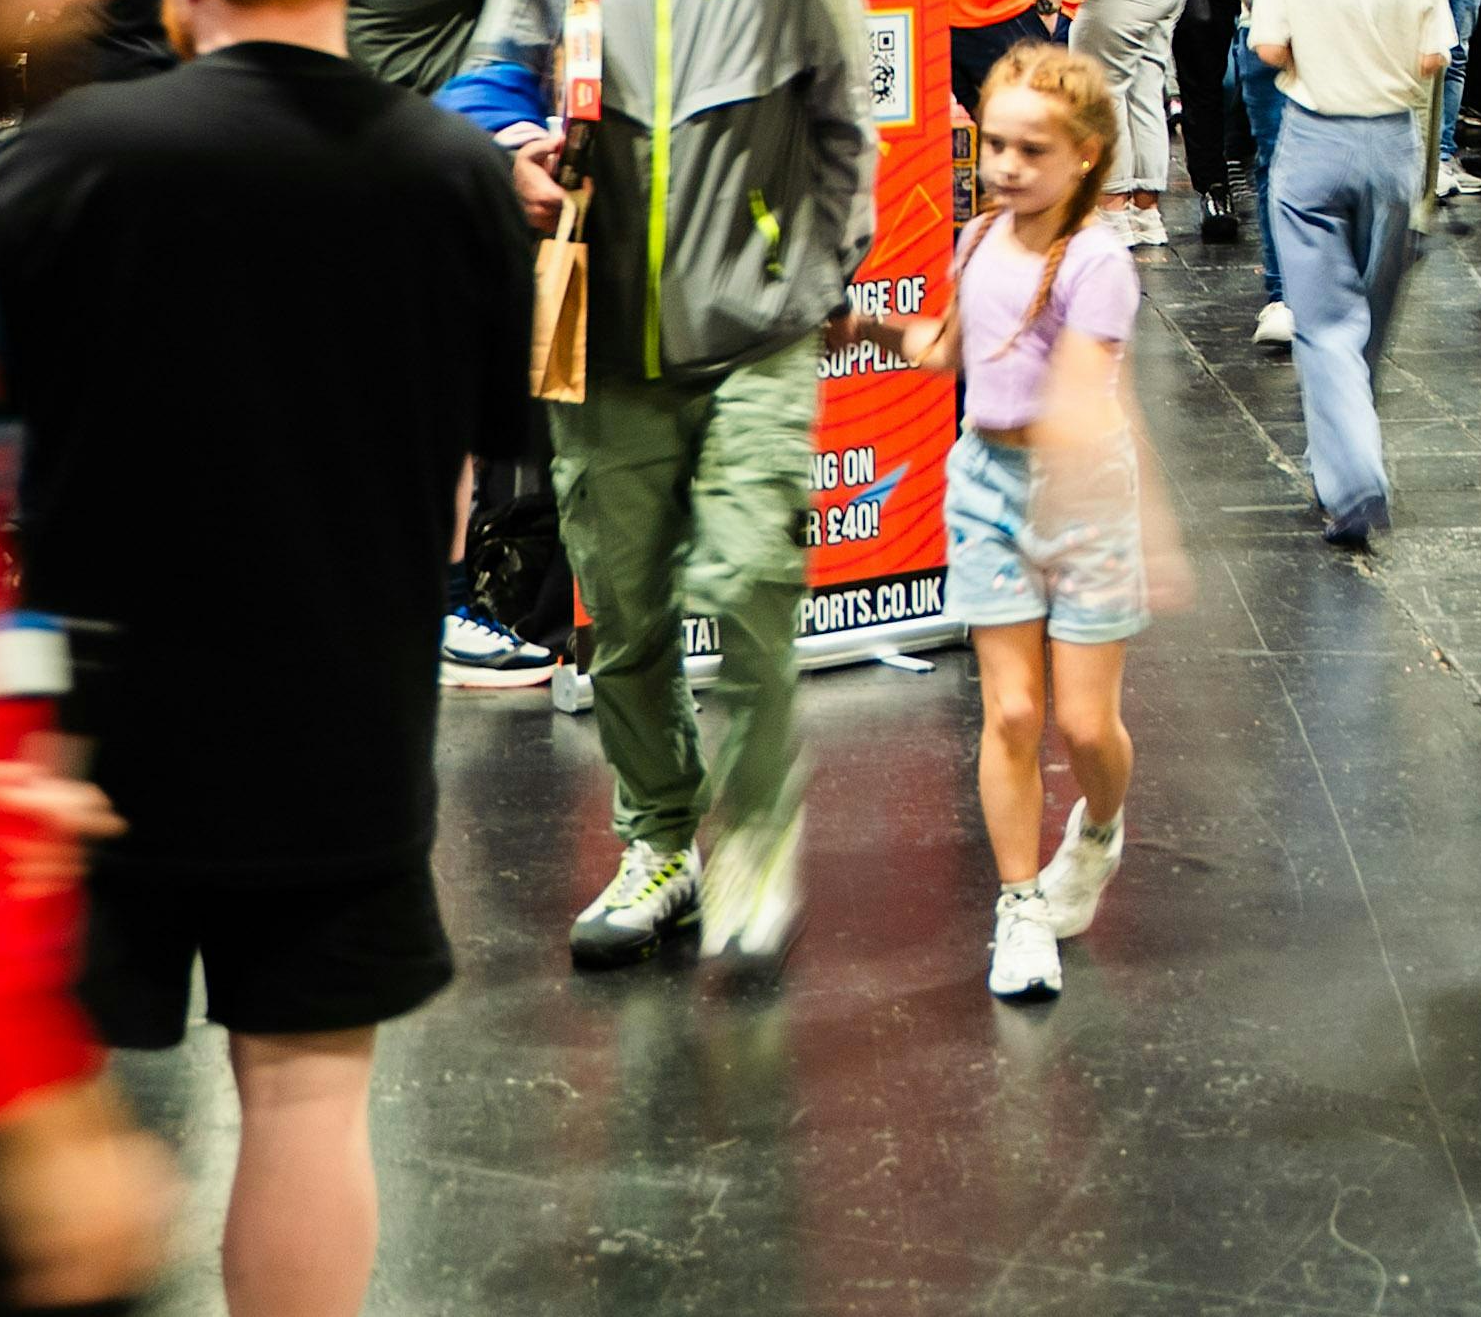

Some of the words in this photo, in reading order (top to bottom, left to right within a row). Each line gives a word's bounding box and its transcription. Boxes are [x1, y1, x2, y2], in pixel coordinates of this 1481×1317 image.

[847, 280, 892, 317] NGE
[897, 276, 926, 315] OF
[809, 452, 839, 491] NG
[842, 445, 875, 486] ON
[826, 500, 880, 545] £40!
[800, 576, 942, 634] PORTS.CO.UK
